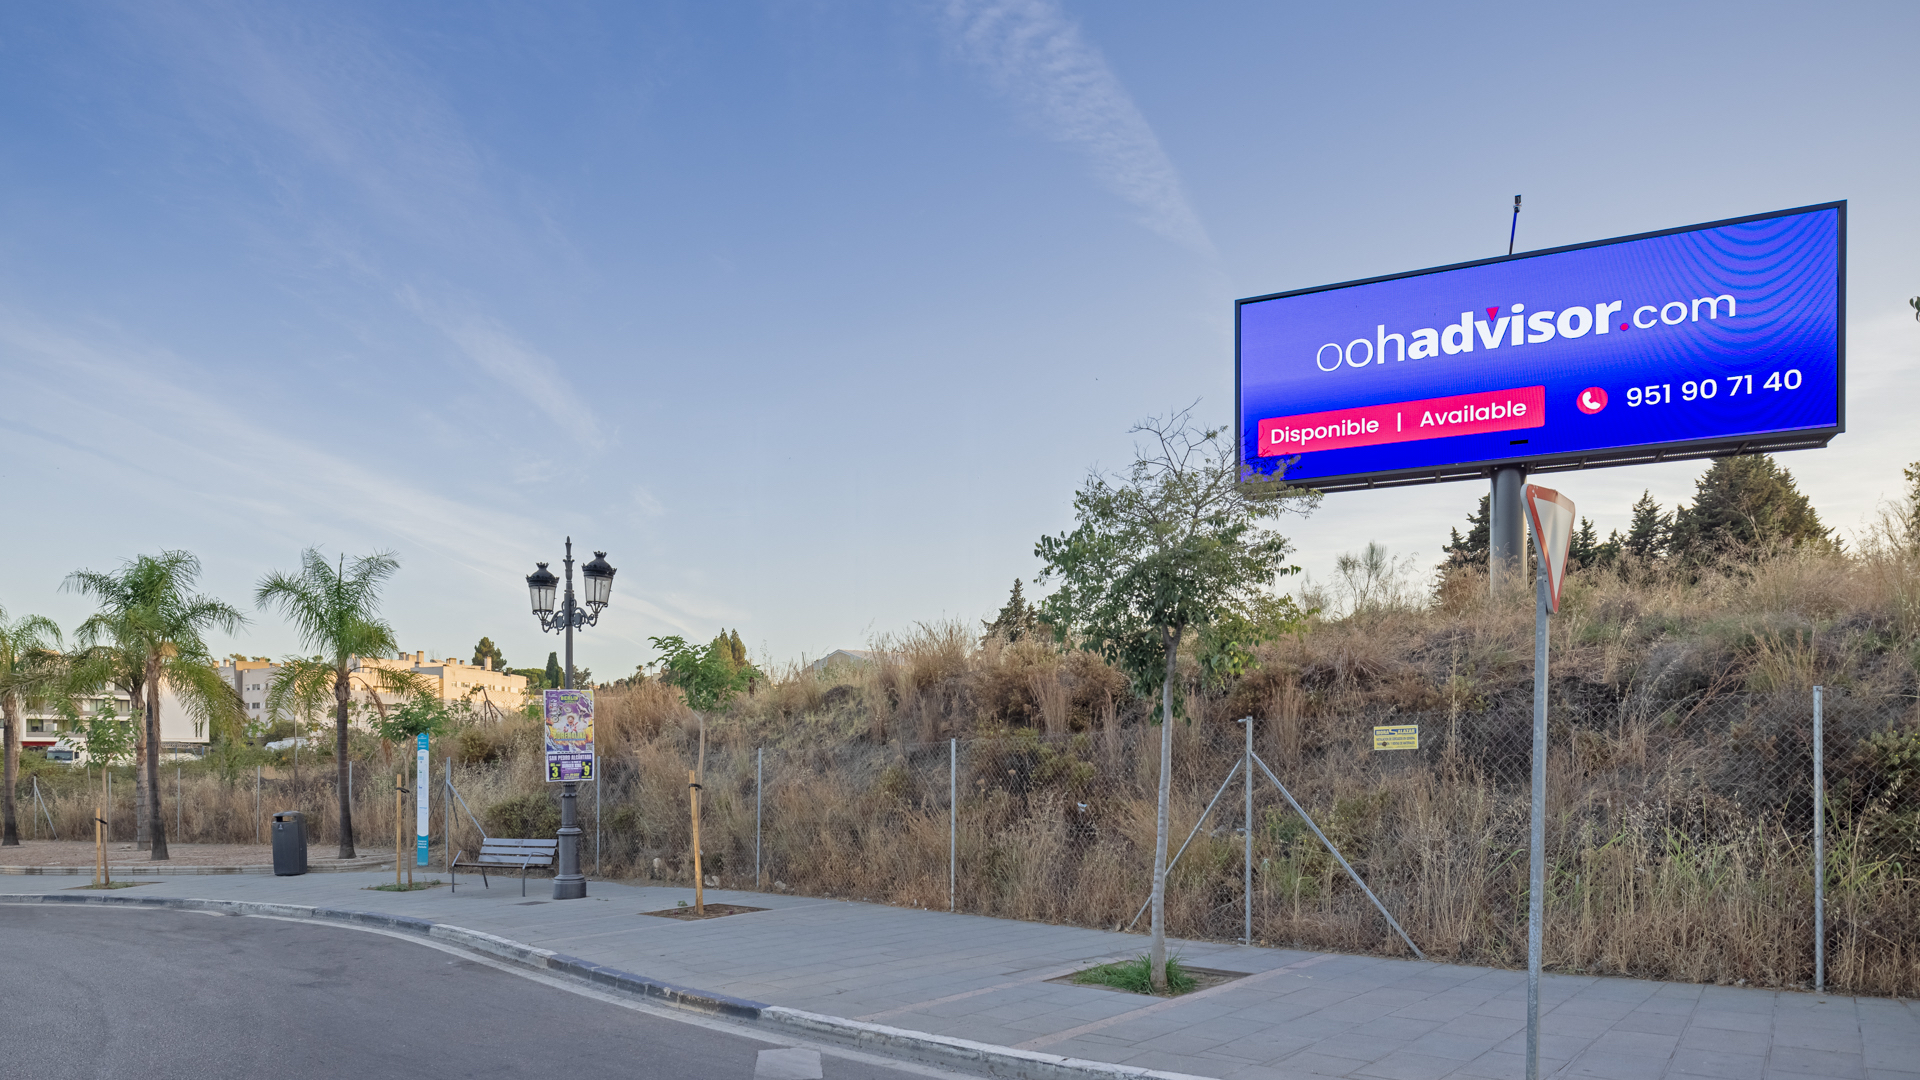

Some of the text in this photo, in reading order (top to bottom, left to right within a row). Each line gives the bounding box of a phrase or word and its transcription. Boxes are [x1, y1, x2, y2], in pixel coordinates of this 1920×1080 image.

[1316, 293, 1737, 373] oohadvisor.com
[1626, 369, 1802, 407] 951 90 71 40
[1271, 400, 1527, 446] Disponible Available
[552, 766, 558, 777] 3
[584, 765, 590, 776] 9
